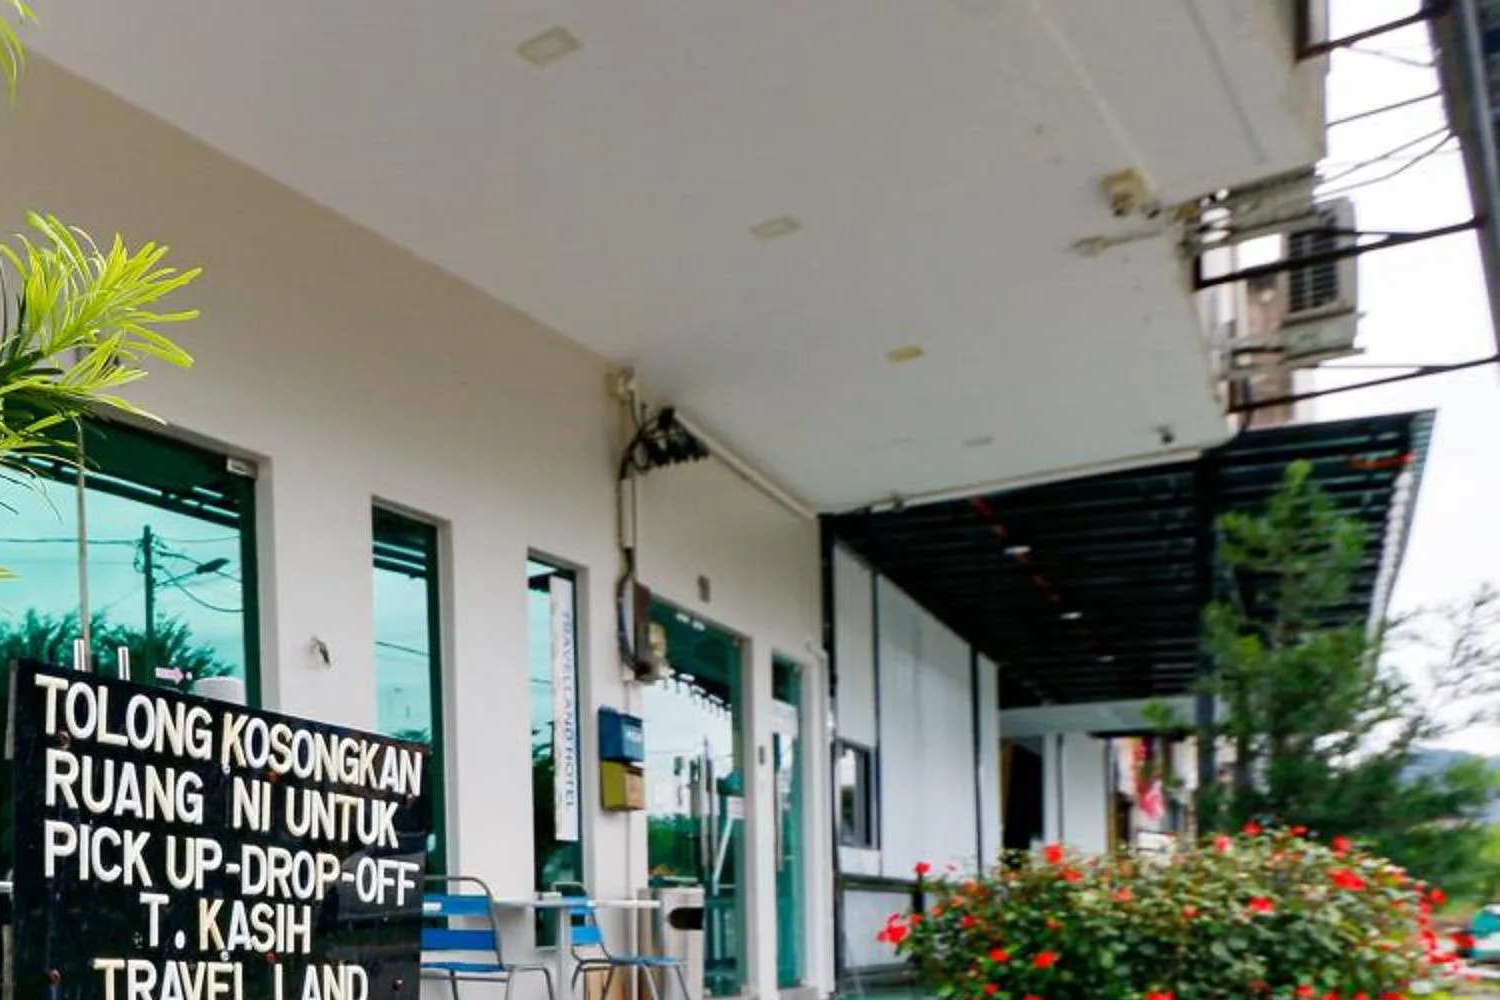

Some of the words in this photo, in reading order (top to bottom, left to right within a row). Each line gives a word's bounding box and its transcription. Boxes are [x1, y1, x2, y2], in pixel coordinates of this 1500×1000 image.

[35, 673, 212, 760] TOLONG
[221, 712, 423, 797] KOSONGKAN
[44, 748, 203, 825] RUANG
[233, 777, 271, 833] NI
[285, 789, 399, 848] UNTUK
[44, 820, 152, 888] PICK
[200, 898, 311, 955] KASIH
